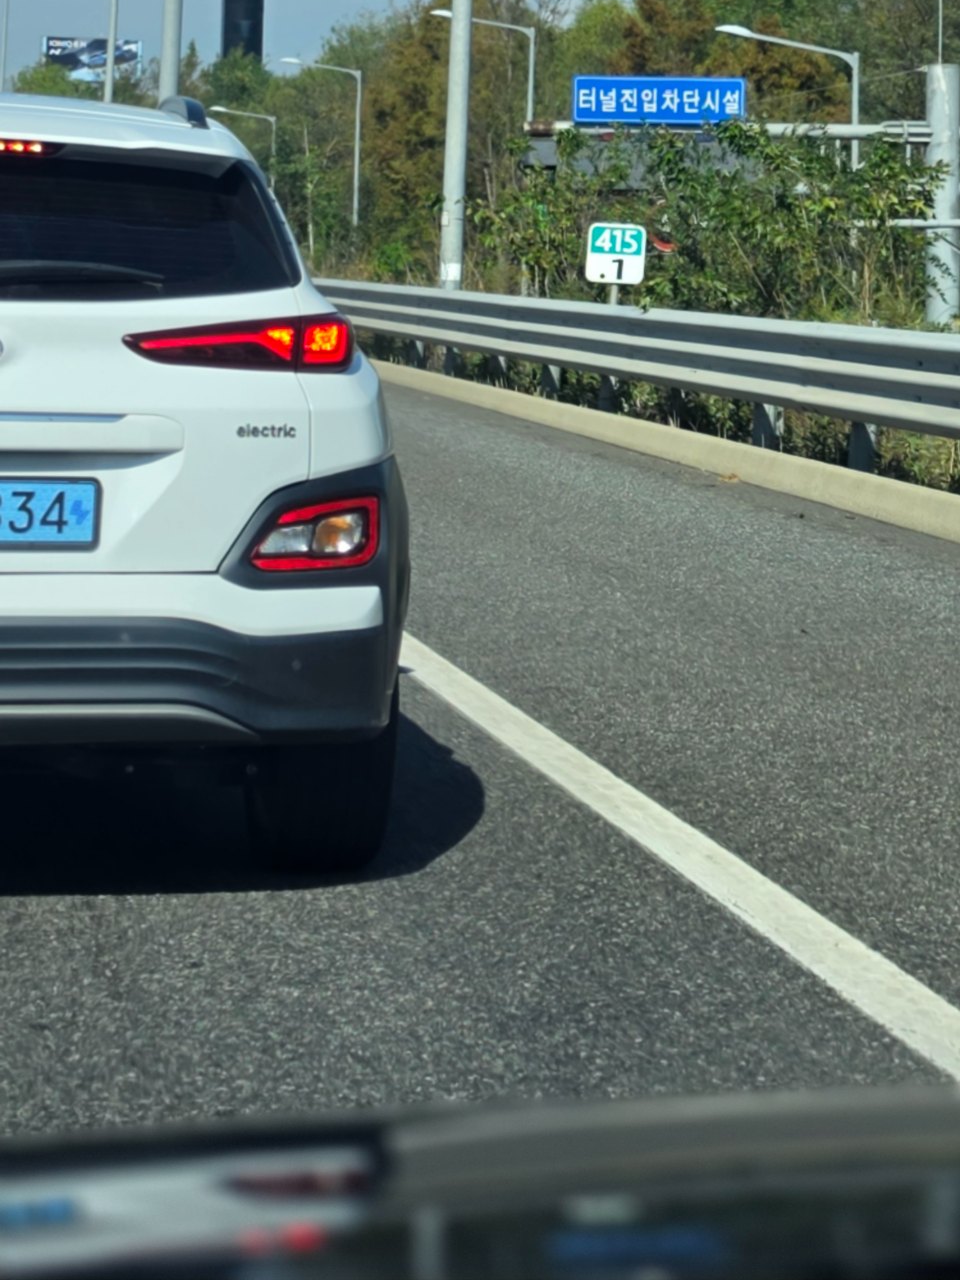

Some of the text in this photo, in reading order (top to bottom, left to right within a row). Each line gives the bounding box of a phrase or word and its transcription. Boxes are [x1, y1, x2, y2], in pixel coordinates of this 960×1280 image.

[578, 87, 740, 114] 터널진입차단시설
[594, 228, 638, 253] 415
[612, 259, 624, 280] 1
[236, 423, 296, 438] electric
[0, 491, 68, 534] 34
